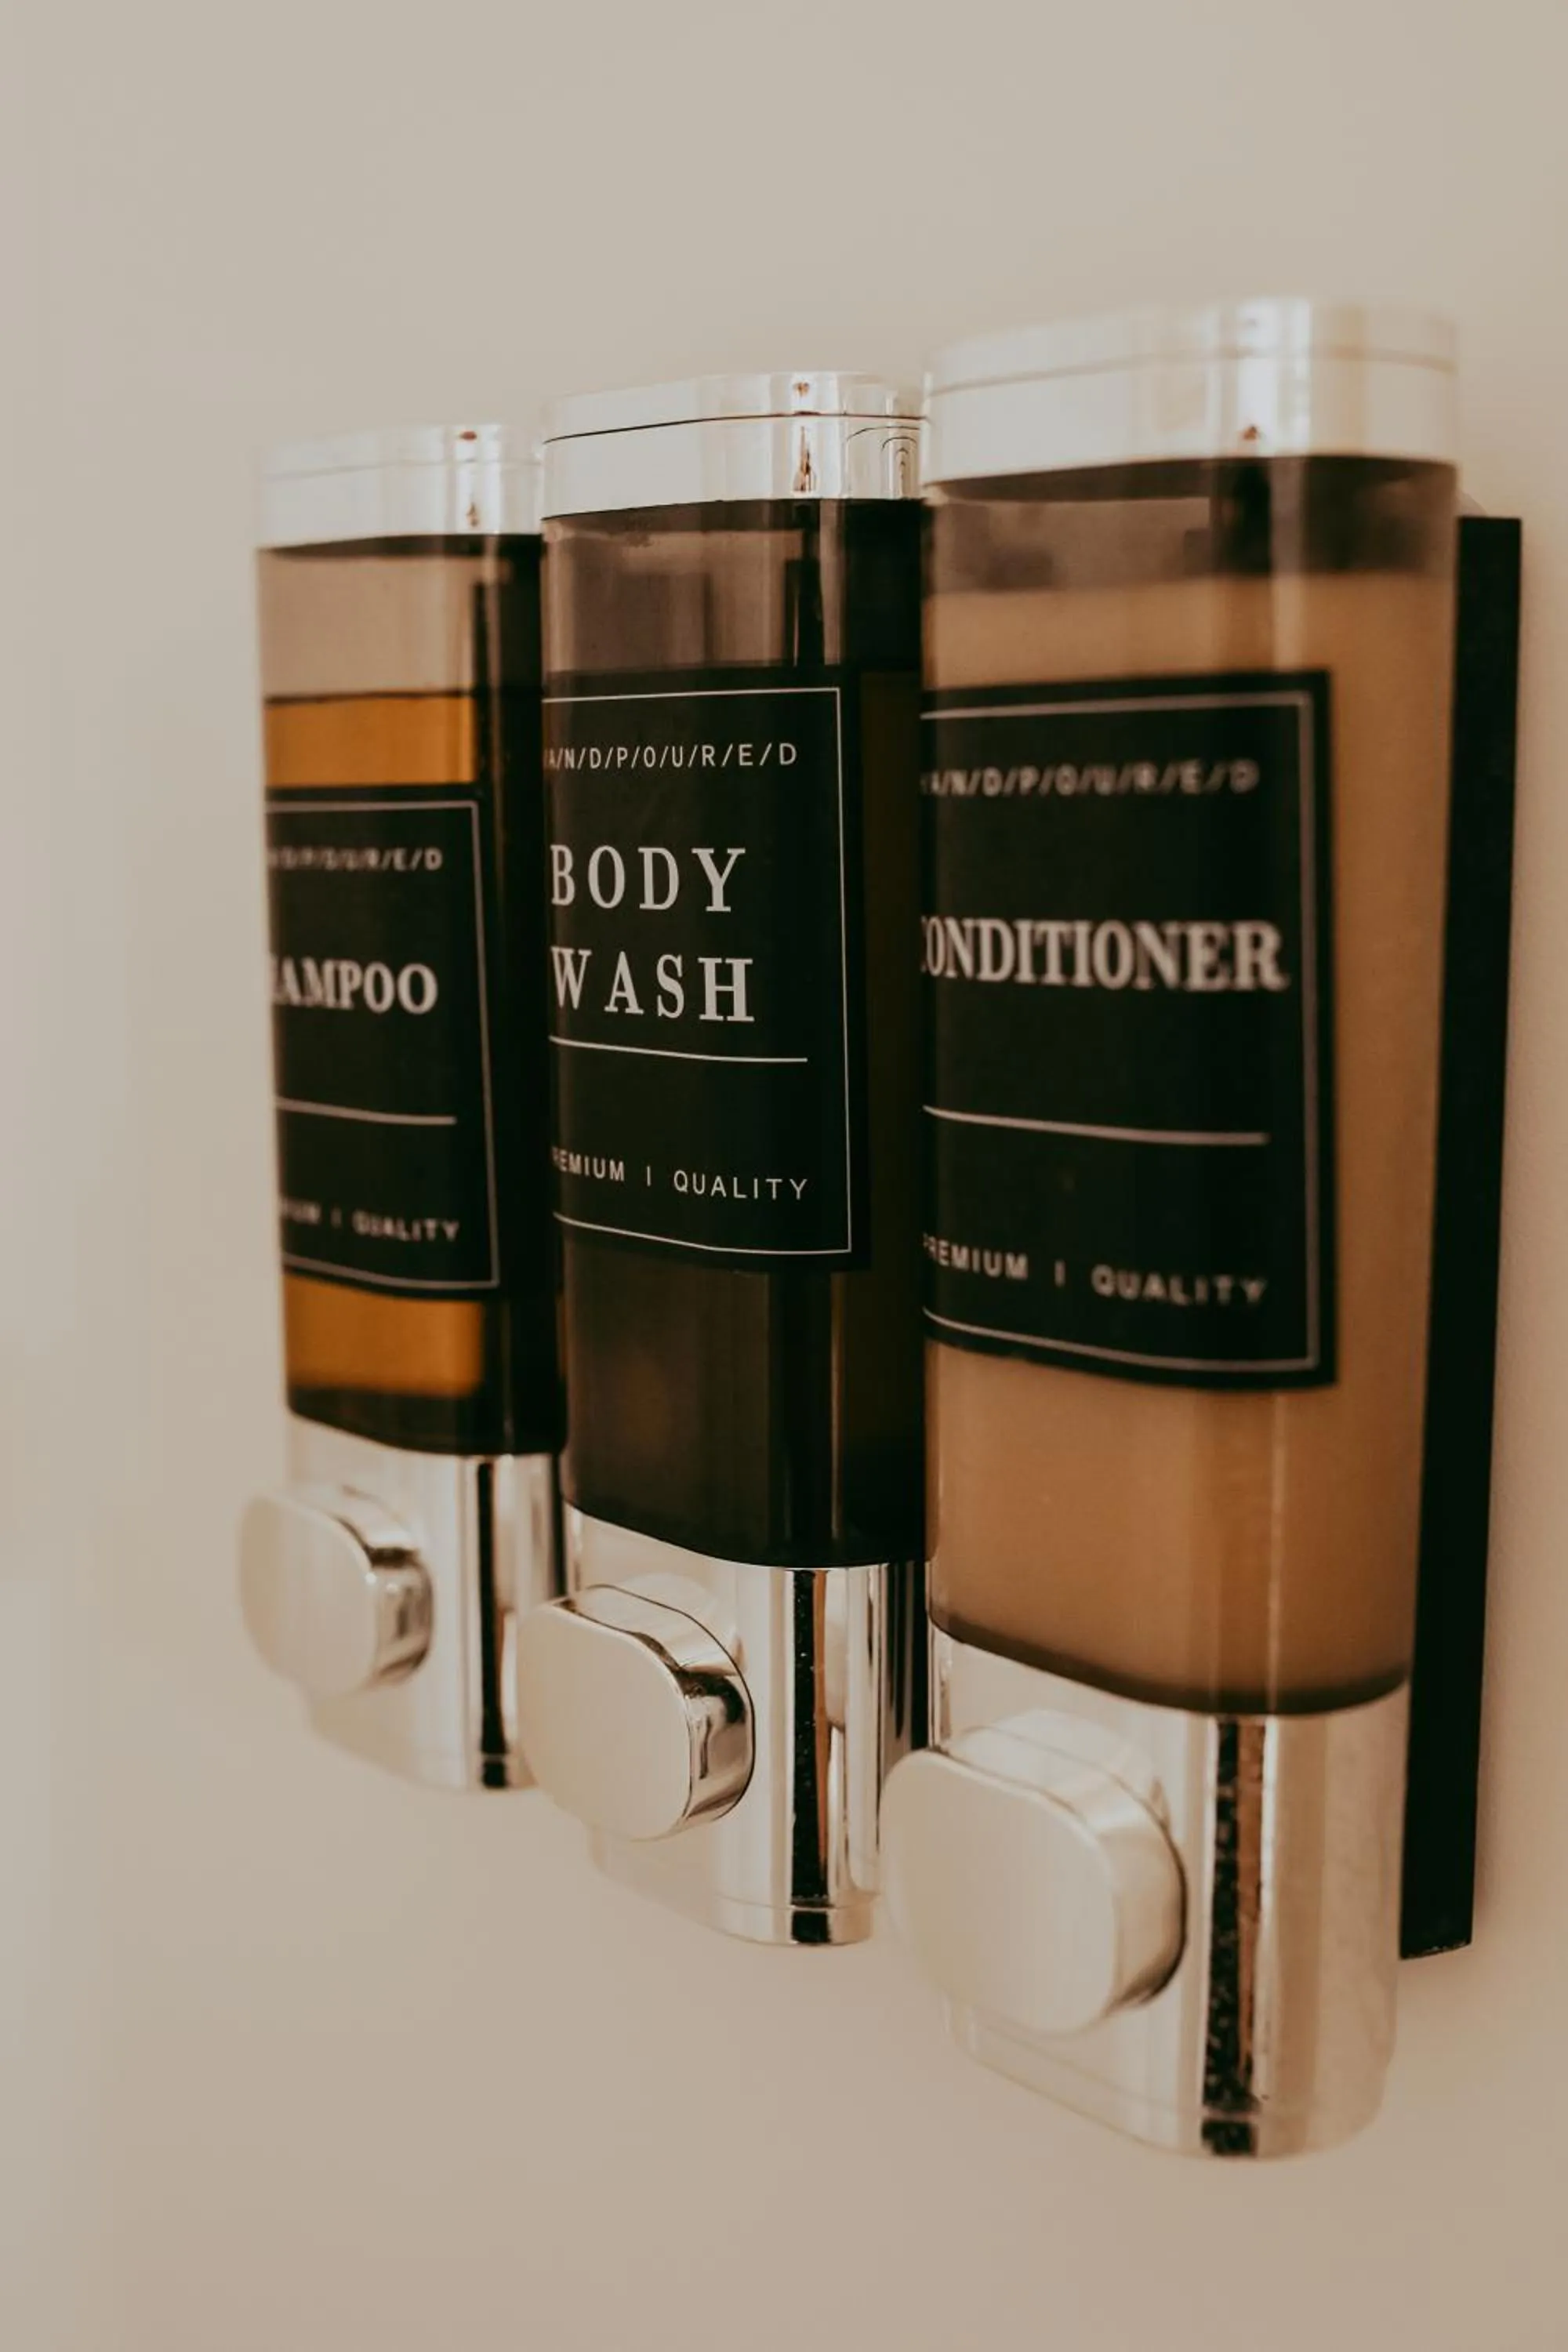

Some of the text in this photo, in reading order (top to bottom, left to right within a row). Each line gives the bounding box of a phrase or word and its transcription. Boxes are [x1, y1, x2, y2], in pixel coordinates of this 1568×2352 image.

[550, 844, 746, 913] BODY
[272, 953, 438, 1014] AMPOO
[550, 946, 755, 1022] WASH
[920, 915, 1290, 993] ONDITIONER
[673, 1169, 808, 1200] QUALITY
[1091, 1263, 1268, 1306] QUALITY
